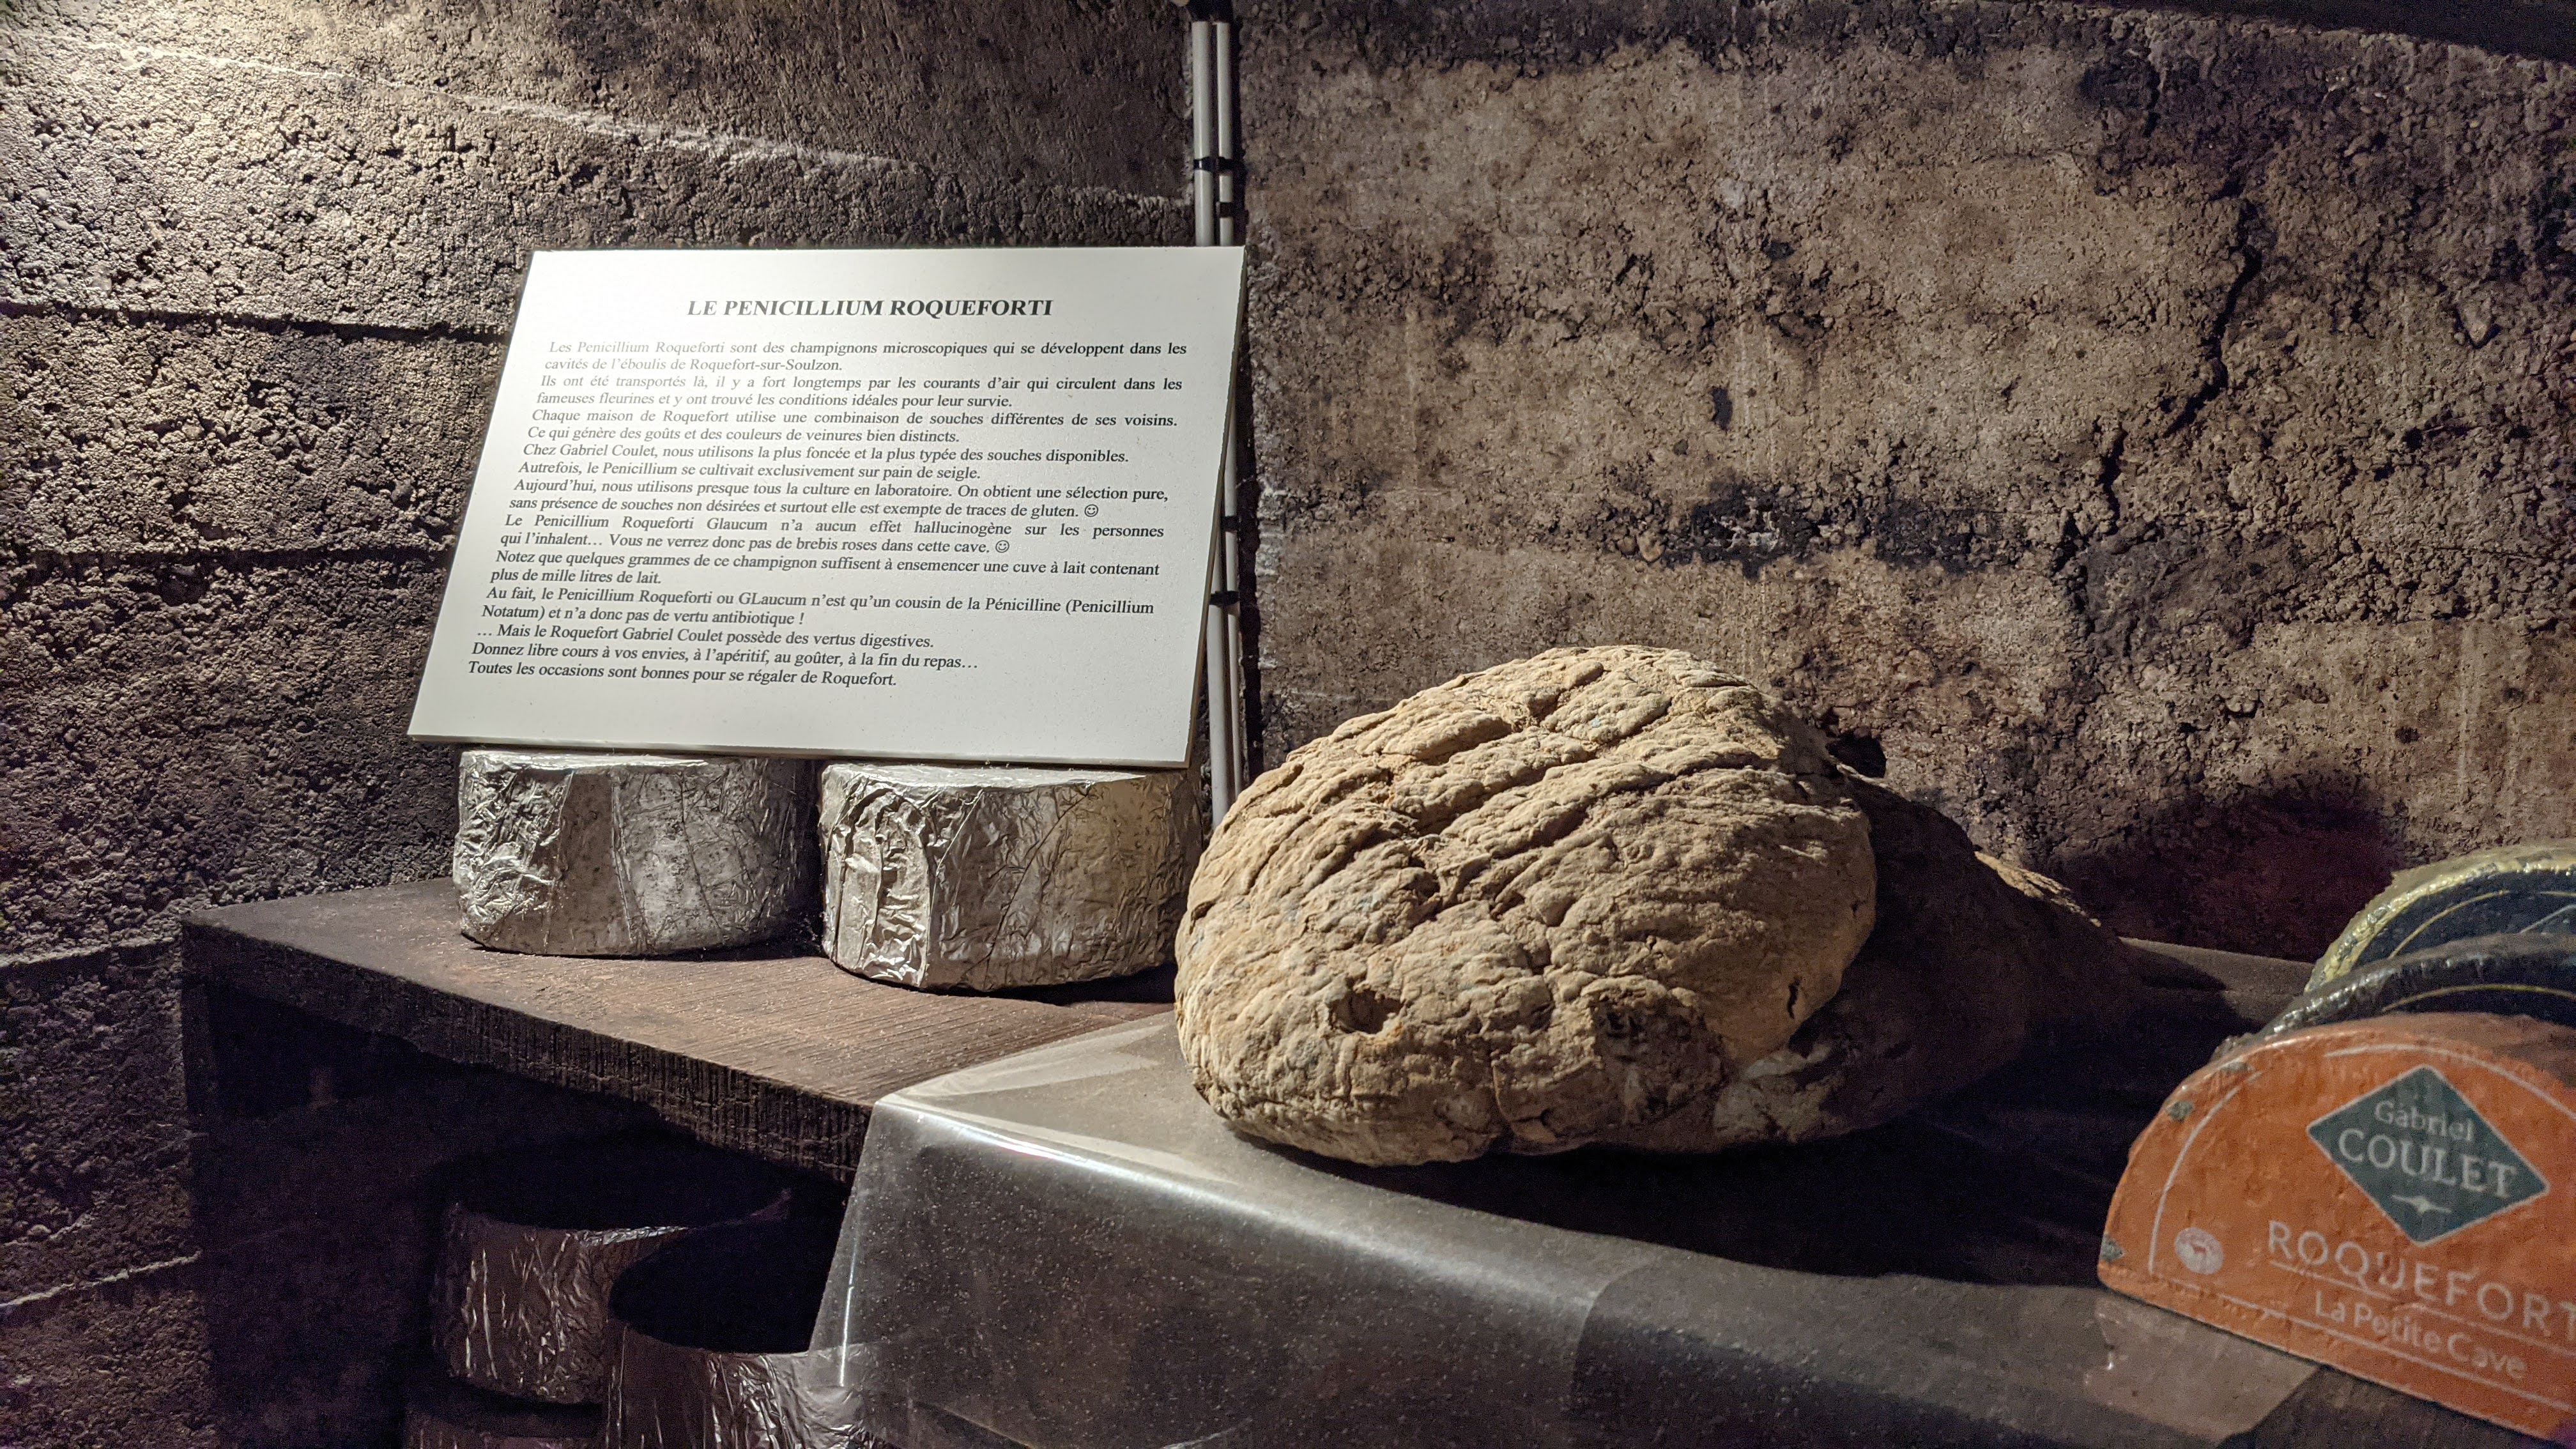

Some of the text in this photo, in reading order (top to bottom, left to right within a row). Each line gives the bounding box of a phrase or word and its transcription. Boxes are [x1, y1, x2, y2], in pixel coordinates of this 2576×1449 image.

[686, 300, 1054, 319] LE PENICILLIUM ROQUEFORTI
[549, 341, 1187, 357] Les Penicillium Roqueforti sont des champignons microscopiques qui se développent dans les
[532, 409, 1177, 427] Chaque maison de Roquefort utilise une combinaison de souches différentes de ses voisins.
[528, 426, 960, 442] Ce qui génère des goûts et des couleurs de veinures bien distincts.
[523, 443, 1129, 465] Chez Gabriel Coulet, nous utilisons la plus foncée et la plus typée des souches disponibles.
[518, 461, 981, 482] Autrefois, le Penicillium se cultivait exclusivement sur pain de seigle.
[513, 479, 1168, 503] Aujourd’hui, nous utilisons presque tous la culture en laboratoire. On obtient une sélection pure,
[509, 497, 1078, 519] sans présence de souches non désirées et surtout elle est exempte de traces de gluten.
[504, 514, 1164, 540] Le Penicillium Roqueforti Glaucum n’a aucun effet hallucinogène sur les personnes
[495, 550, 1160, 576] Notez que quelques grammes de ce champignon suffisent à ensemencer une cuve à lait contenant
[486, 586, 1154, 615] Au fait, le Penicillium Roqueforti ou GLaucum n’est qu’un cousin de la Pénicilline (Penicillium
[468, 661, 896, 688] Toutes les occasions sont bonnes pour se régaler de Roquefort.
[2375, 1100, 2474, 1142] Gabriel
[2338, 1127, 2517, 1199] COULET
[2269, 1220, 2576, 1341] ROQUEFORT
[2315, 1290, 2526, 1379] La Petite Cave
